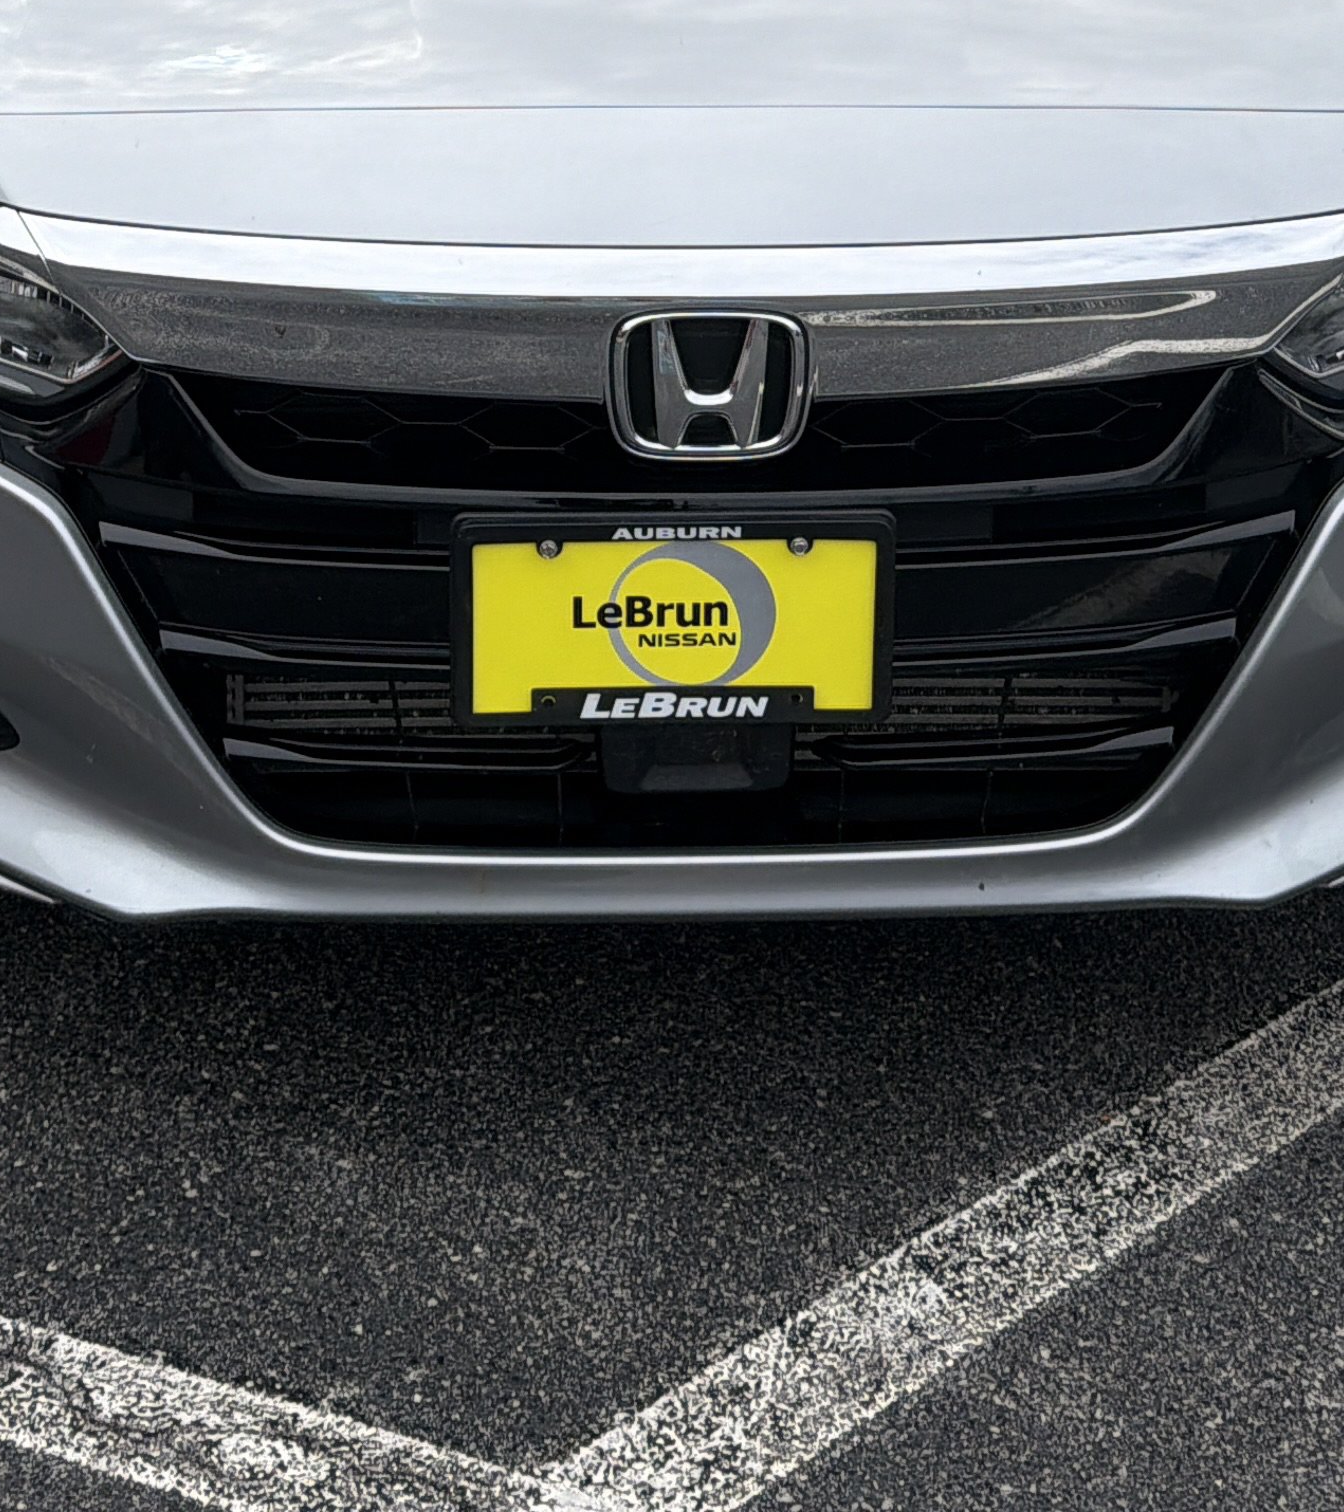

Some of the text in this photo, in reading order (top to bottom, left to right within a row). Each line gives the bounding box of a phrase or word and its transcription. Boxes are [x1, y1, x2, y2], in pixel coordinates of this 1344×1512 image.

[611, 526, 742, 540] AUBURN
[572, 595, 729, 629] LeBrun
[638, 632, 737, 648] NISSAN
